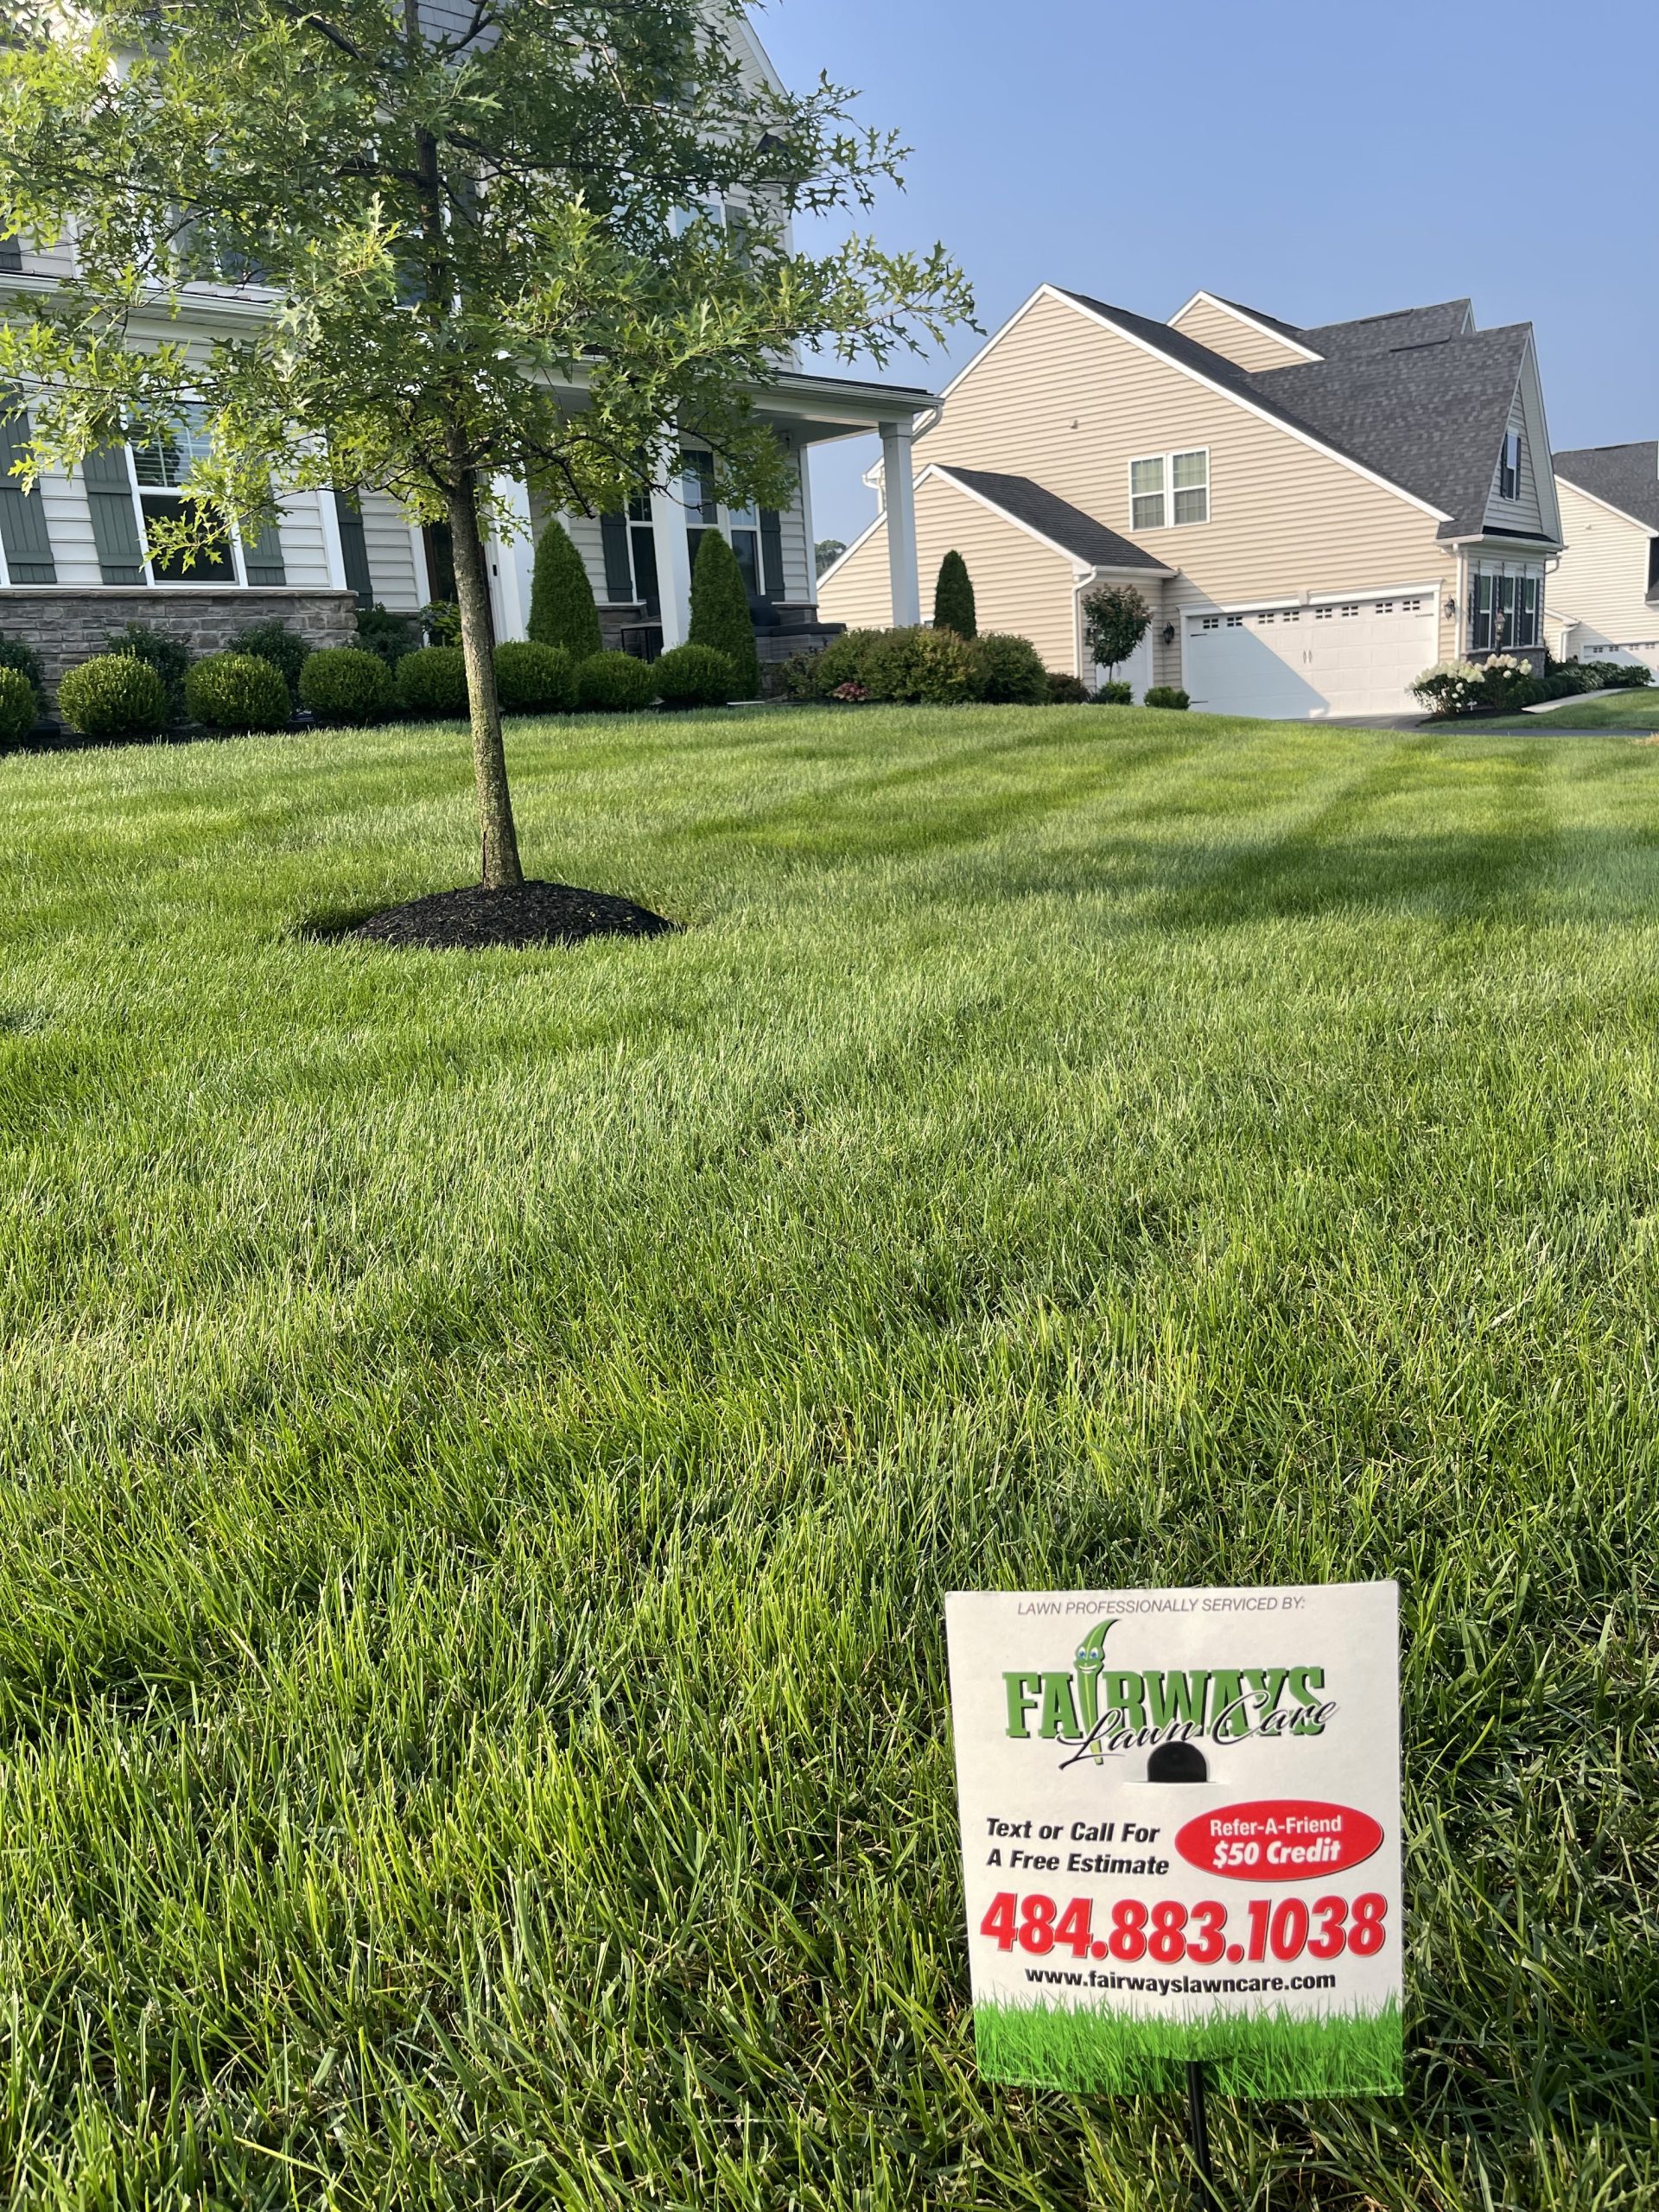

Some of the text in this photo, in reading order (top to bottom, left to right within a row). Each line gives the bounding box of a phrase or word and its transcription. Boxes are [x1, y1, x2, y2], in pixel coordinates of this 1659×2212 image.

[1017, 1597, 1306, 1615] LAWN PROFESSIONALLY SERVICED BY:
[1001, 1667, 1325, 1738] FAIRWAYS
[1056, 1690, 1341, 1770] Lawn Care
[986, 1817, 1160, 1843] Text or Call For
[1210, 1815, 1342, 1837] Refer-A-Friend
[986, 1848, 1170, 1875] A Free Estimate
[1212, 1837, 1341, 1869] $50 Credit
[979, 1891, 1388, 1965] 484.883.1038
[1025, 1968, 1336, 1996] www.fairwayslawncare.com
